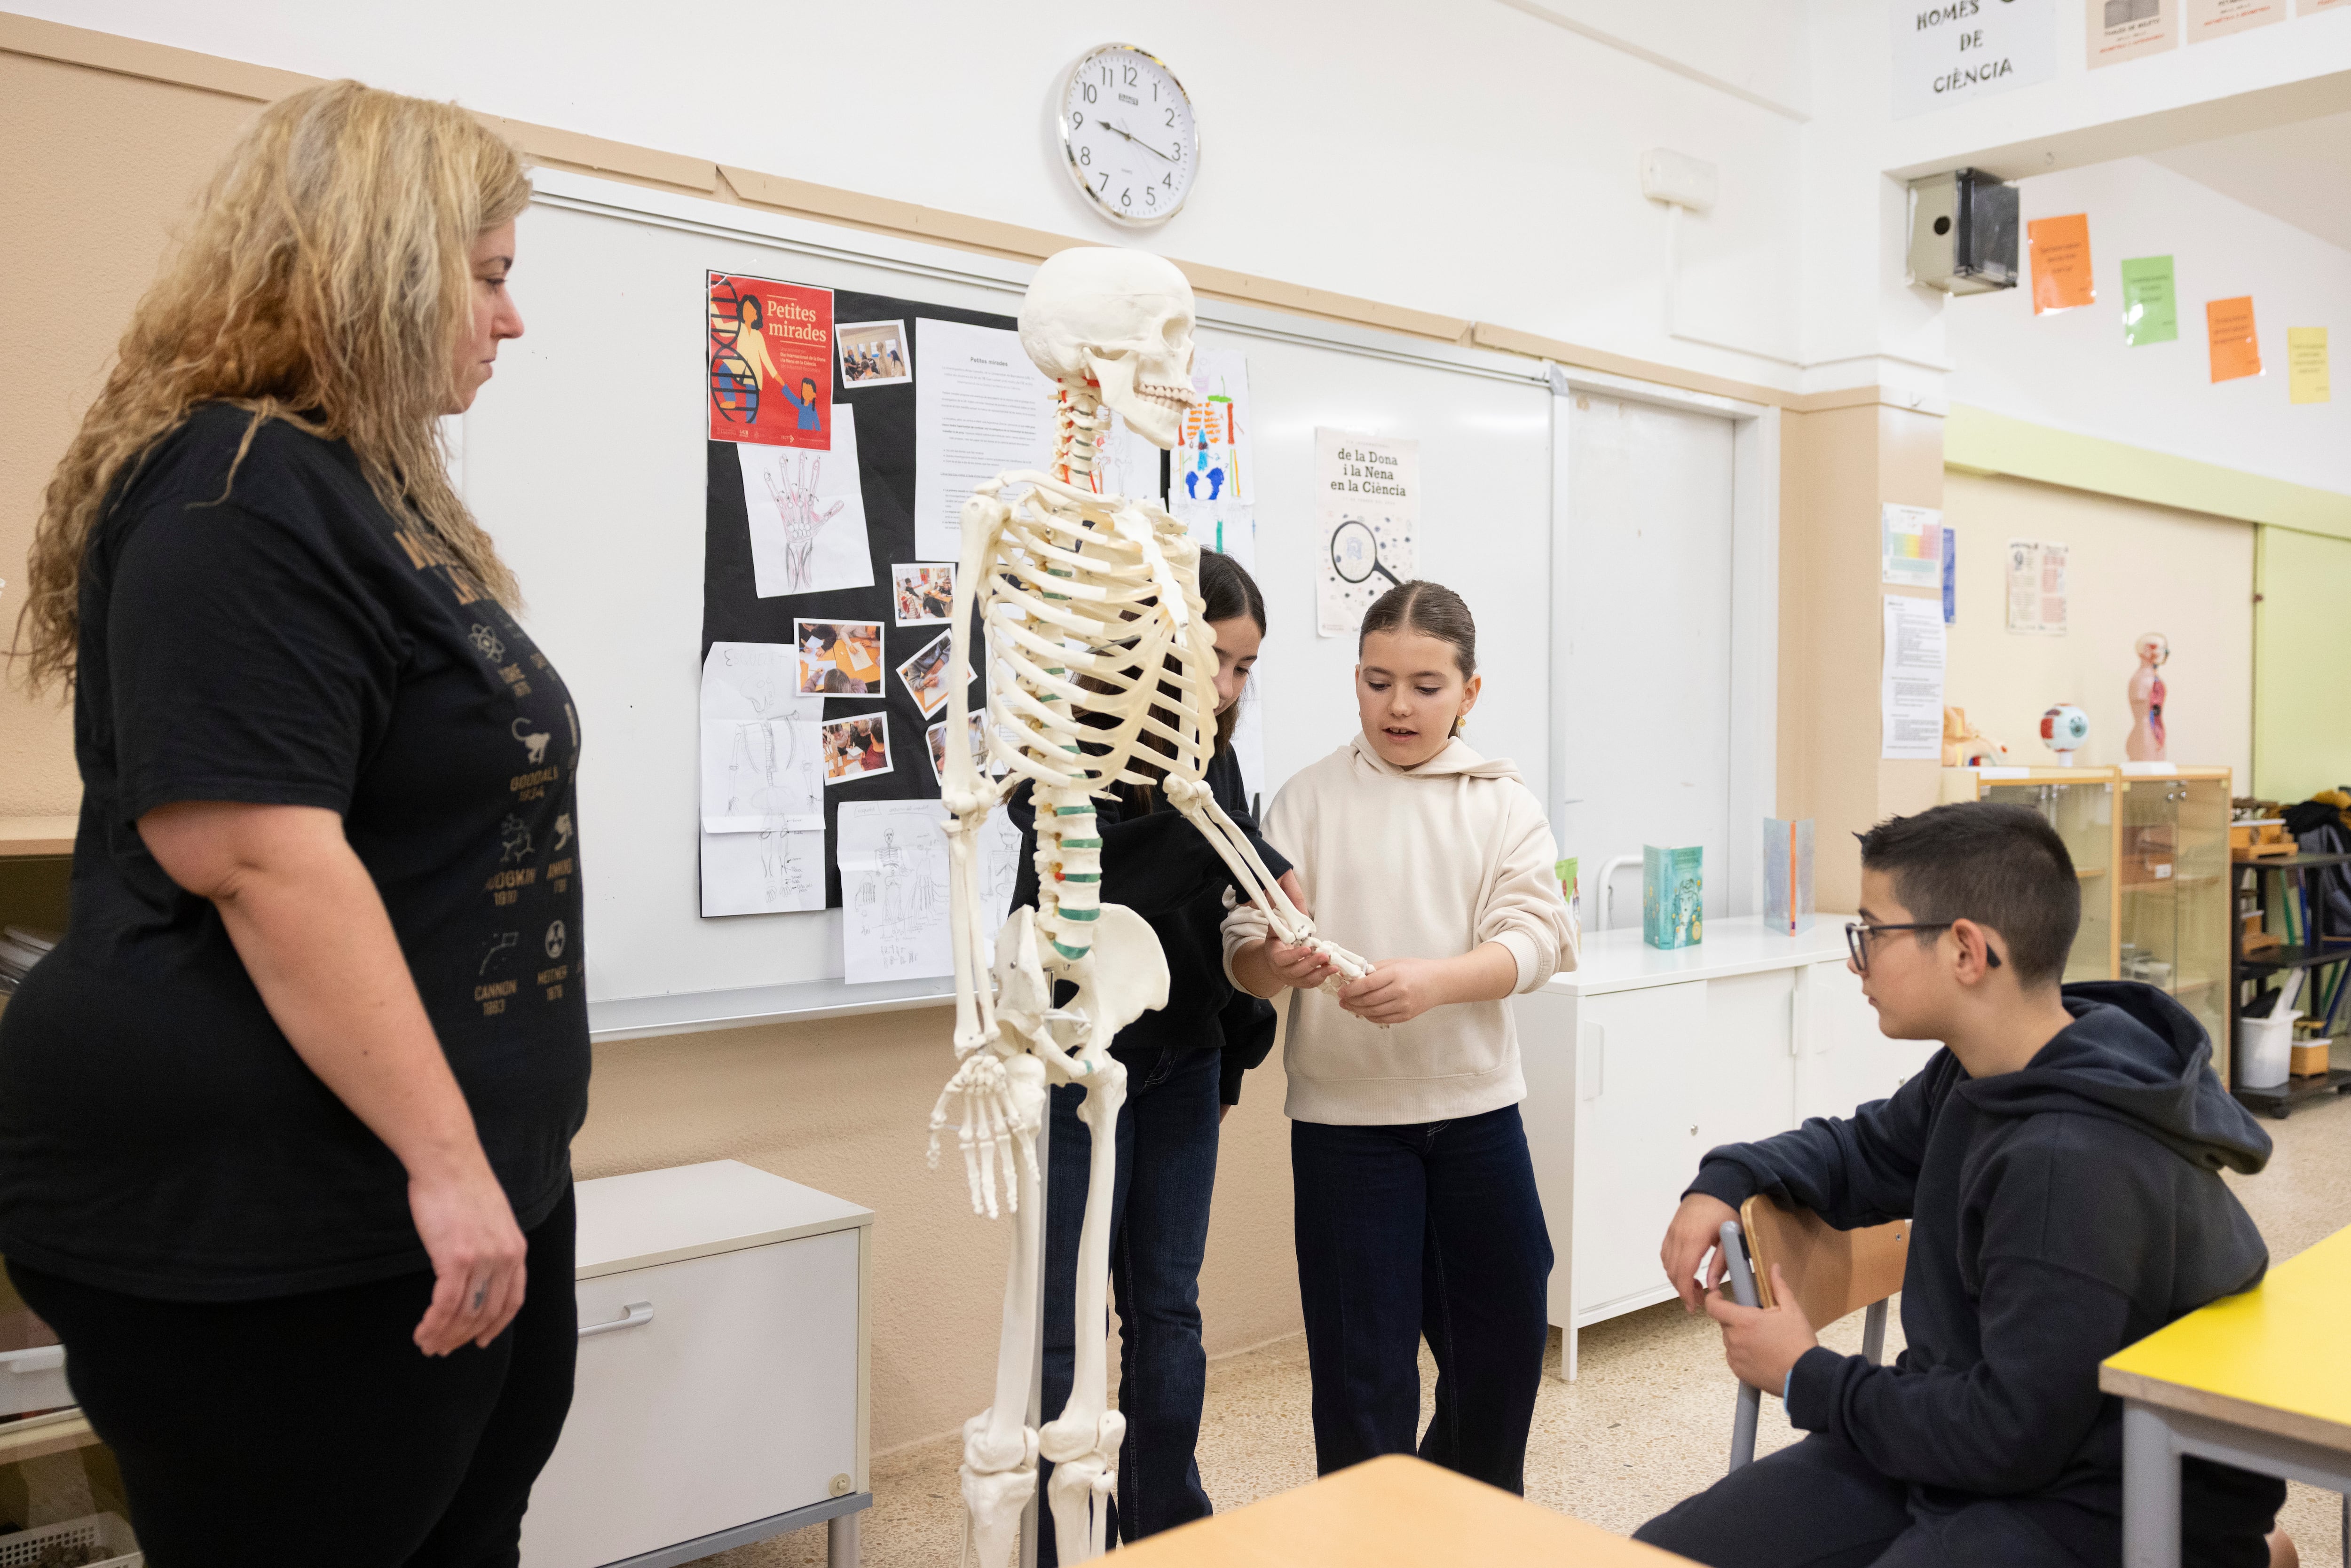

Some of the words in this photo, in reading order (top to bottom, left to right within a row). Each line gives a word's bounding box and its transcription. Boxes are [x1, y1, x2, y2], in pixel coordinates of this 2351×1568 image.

[1917, 0, 1979, 31] HOMES
[1960, 29, 1983, 52] DE
[1101, 66, 1113, 87] 11
[1123, 64, 1137, 87] 12
[1082, 82, 1097, 103] 10
[1153, 83, 1158, 102] 1
[1073, 111, 1083, 130] 9
[1165, 108, 1175, 128] 2
[1081, 146, 1090, 165] 8
[1172, 142, 1181, 161] 3
[1099, 172, 1109, 191] 7
[1162, 172, 1172, 189] 4
[1121, 188, 1131, 206] 6
[1145, 187, 1156, 205] 5
[767, 300, 816, 322] Petites
[769, 320, 826, 342] mirades
[1338, 448, 1351, 460] de
[1355, 449, 1365, 462] la
[1369, 451, 1398, 465] Dona
[1343, 464, 1348, 475] i
[1351, 464, 1361, 477] la
[1365, 465, 1394, 480] Nena
[1331, 481, 1345, 491] en
[1349, 479, 1358, 492] la
[1363, 481, 1406, 496] Ciència
[474, 979, 517, 1001] CANNON
